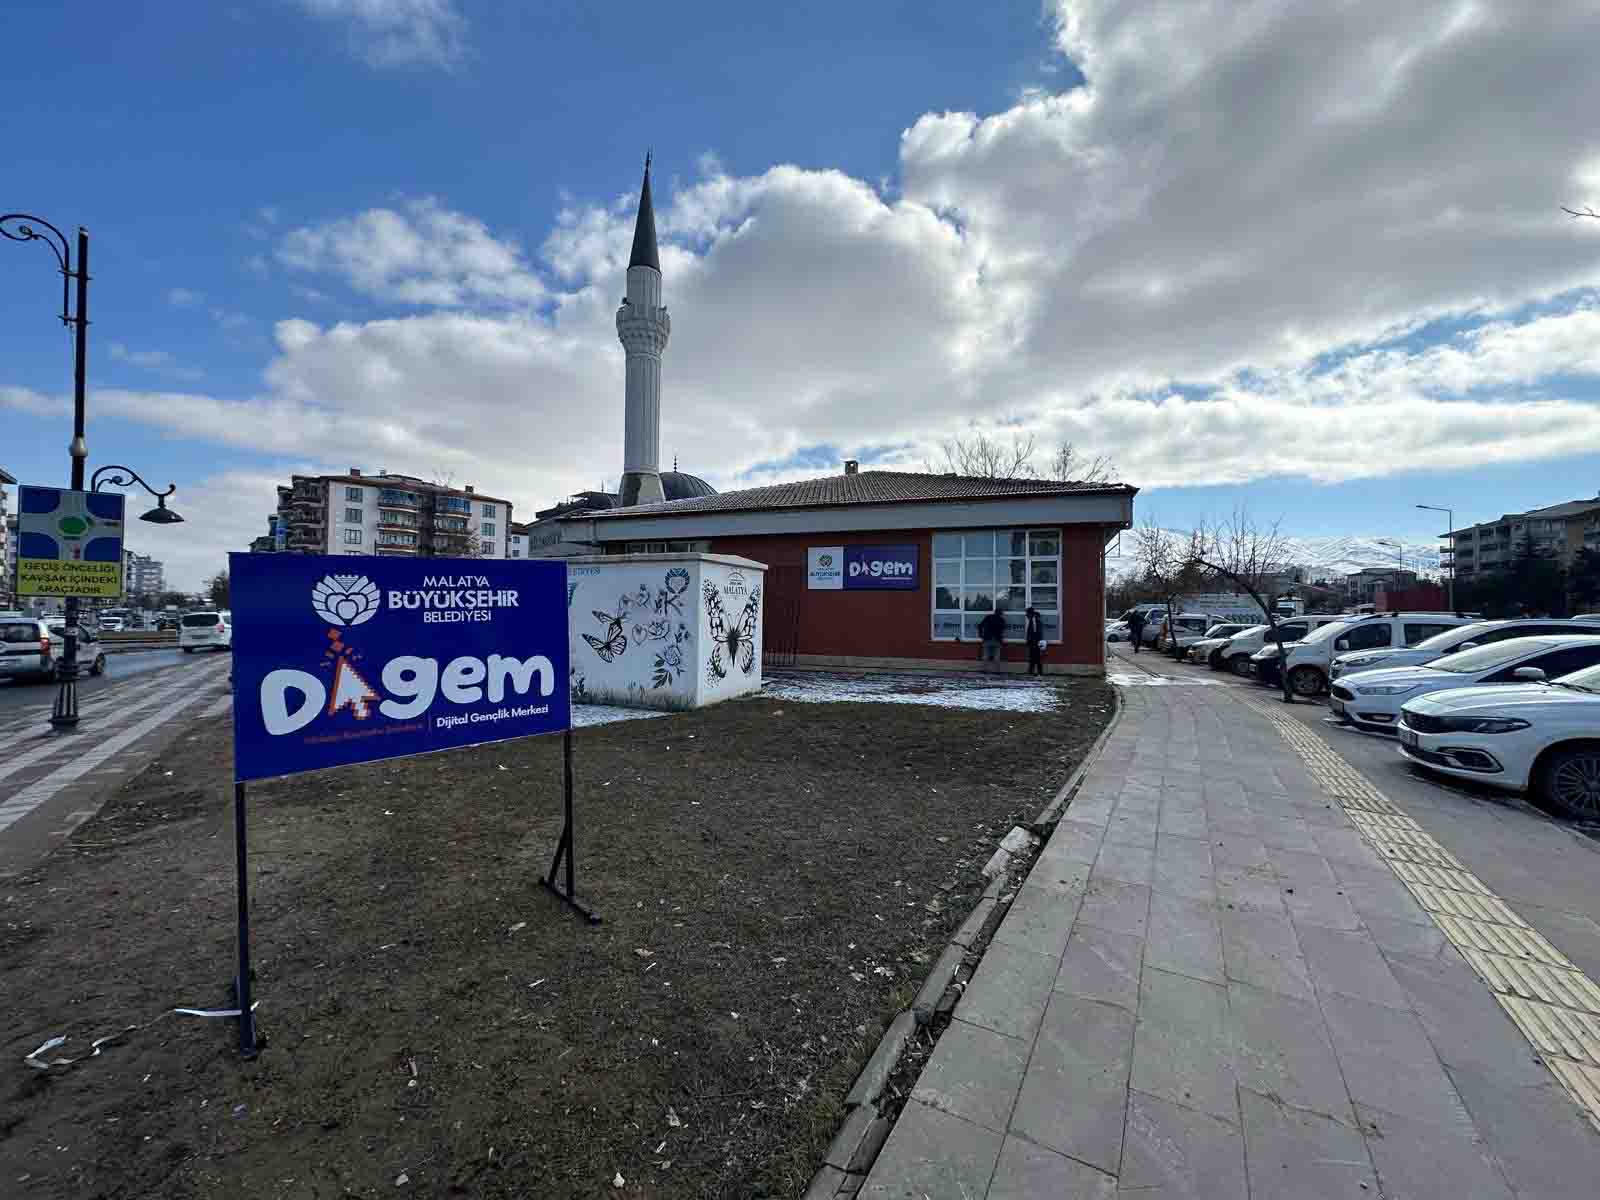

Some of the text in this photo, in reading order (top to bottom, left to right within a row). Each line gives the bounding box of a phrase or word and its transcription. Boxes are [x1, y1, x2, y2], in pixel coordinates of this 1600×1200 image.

[423, 575, 490, 587] MALATYA
[723, 585, 748, 595] MALATYA
[388, 590, 519, 609] BÜYÜKŞEHİR
[423, 610, 491, 623] BELEDİYESİ
[436, 704, 549, 729] Dijital Gençlik Merkezi
